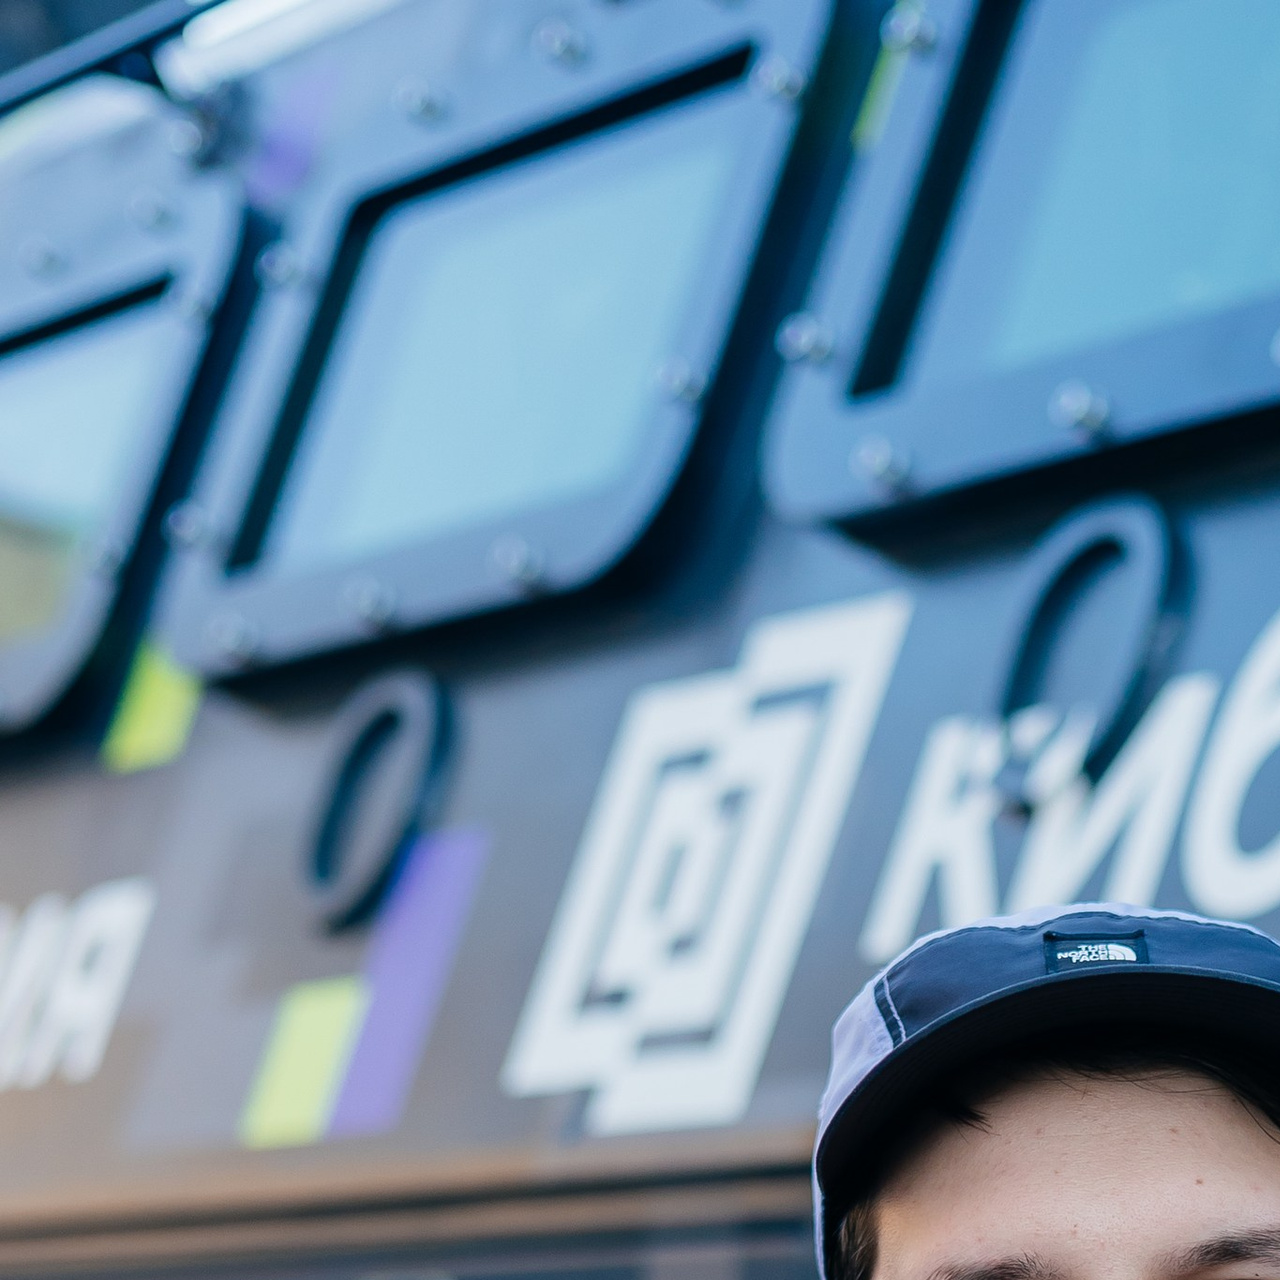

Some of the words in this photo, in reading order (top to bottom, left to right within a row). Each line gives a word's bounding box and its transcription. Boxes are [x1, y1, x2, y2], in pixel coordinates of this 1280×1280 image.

[1077, 944, 1108, 952] THE
[1056, 950, 1108, 960] NORTH
[1071, 954, 1109, 963] FACE
